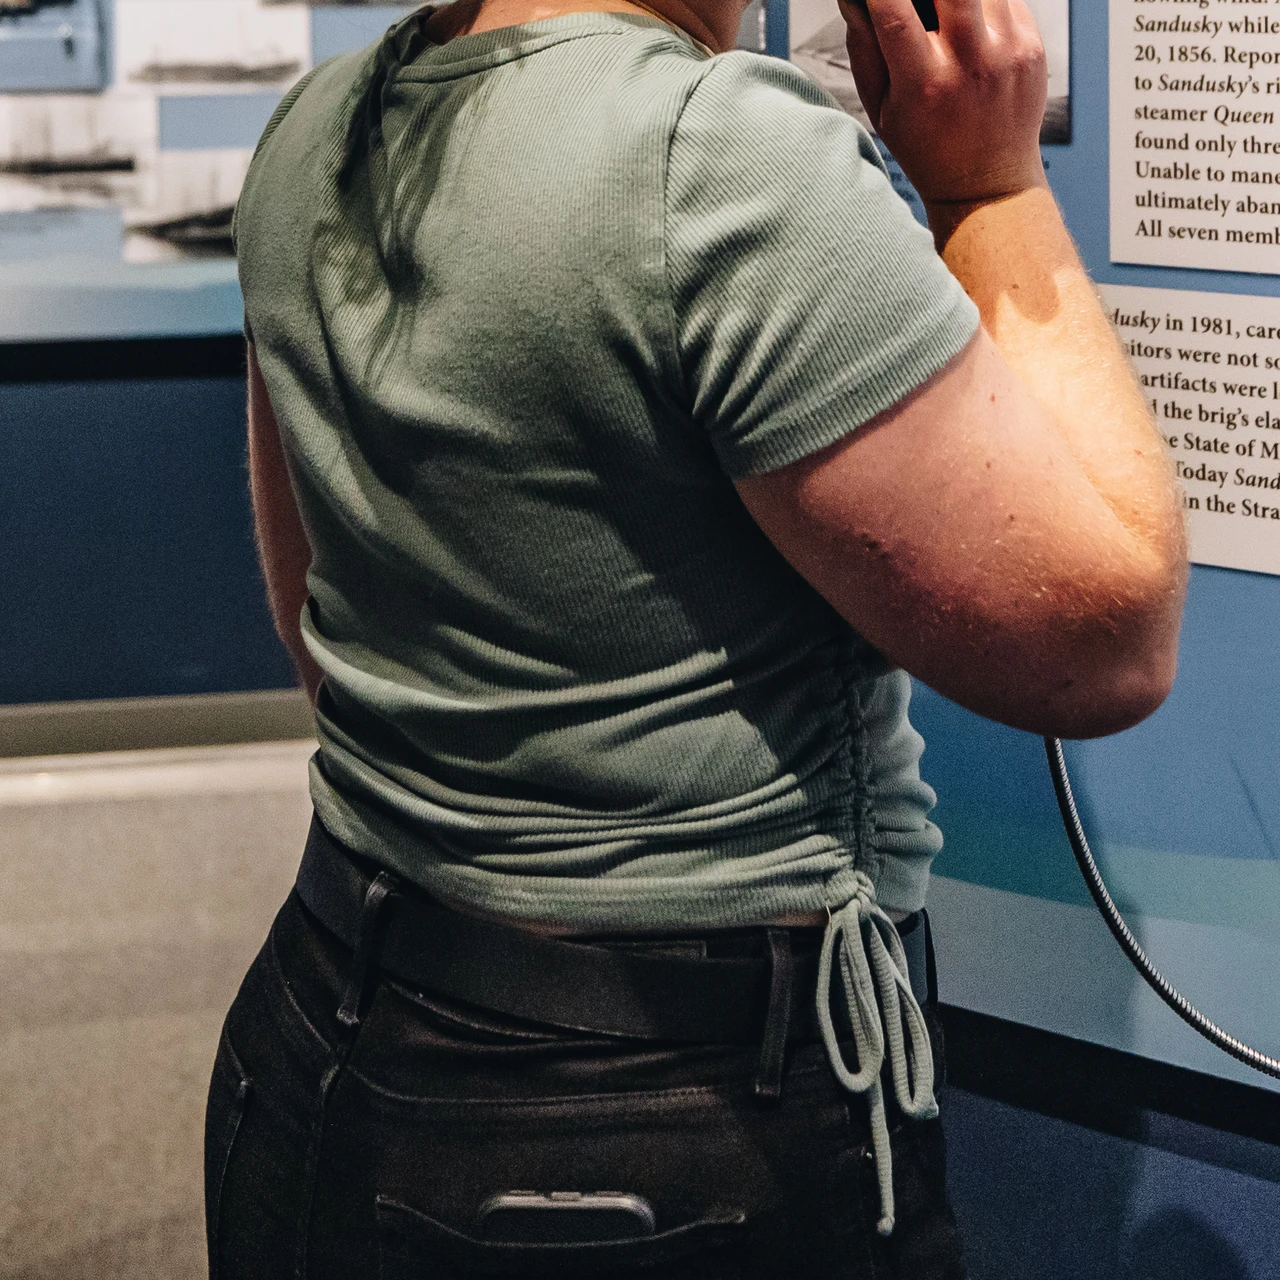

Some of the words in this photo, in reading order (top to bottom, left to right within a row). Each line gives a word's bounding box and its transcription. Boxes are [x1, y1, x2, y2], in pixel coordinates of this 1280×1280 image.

[1165, 312, 1184, 332] in
[1191, 316, 1241, 340] 1981,
[1177, 348, 1222, 365] were
[1226, 352, 1259, 369] not
[1139, 371, 1218, 394] artifacts
[1222, 382, 1268, 399] were
[1163, 400, 1193, 421] the
[1183, 432, 1231, 455] State
[1234, 438, 1257, 458] of
[1205, 493, 1237, 515] the
